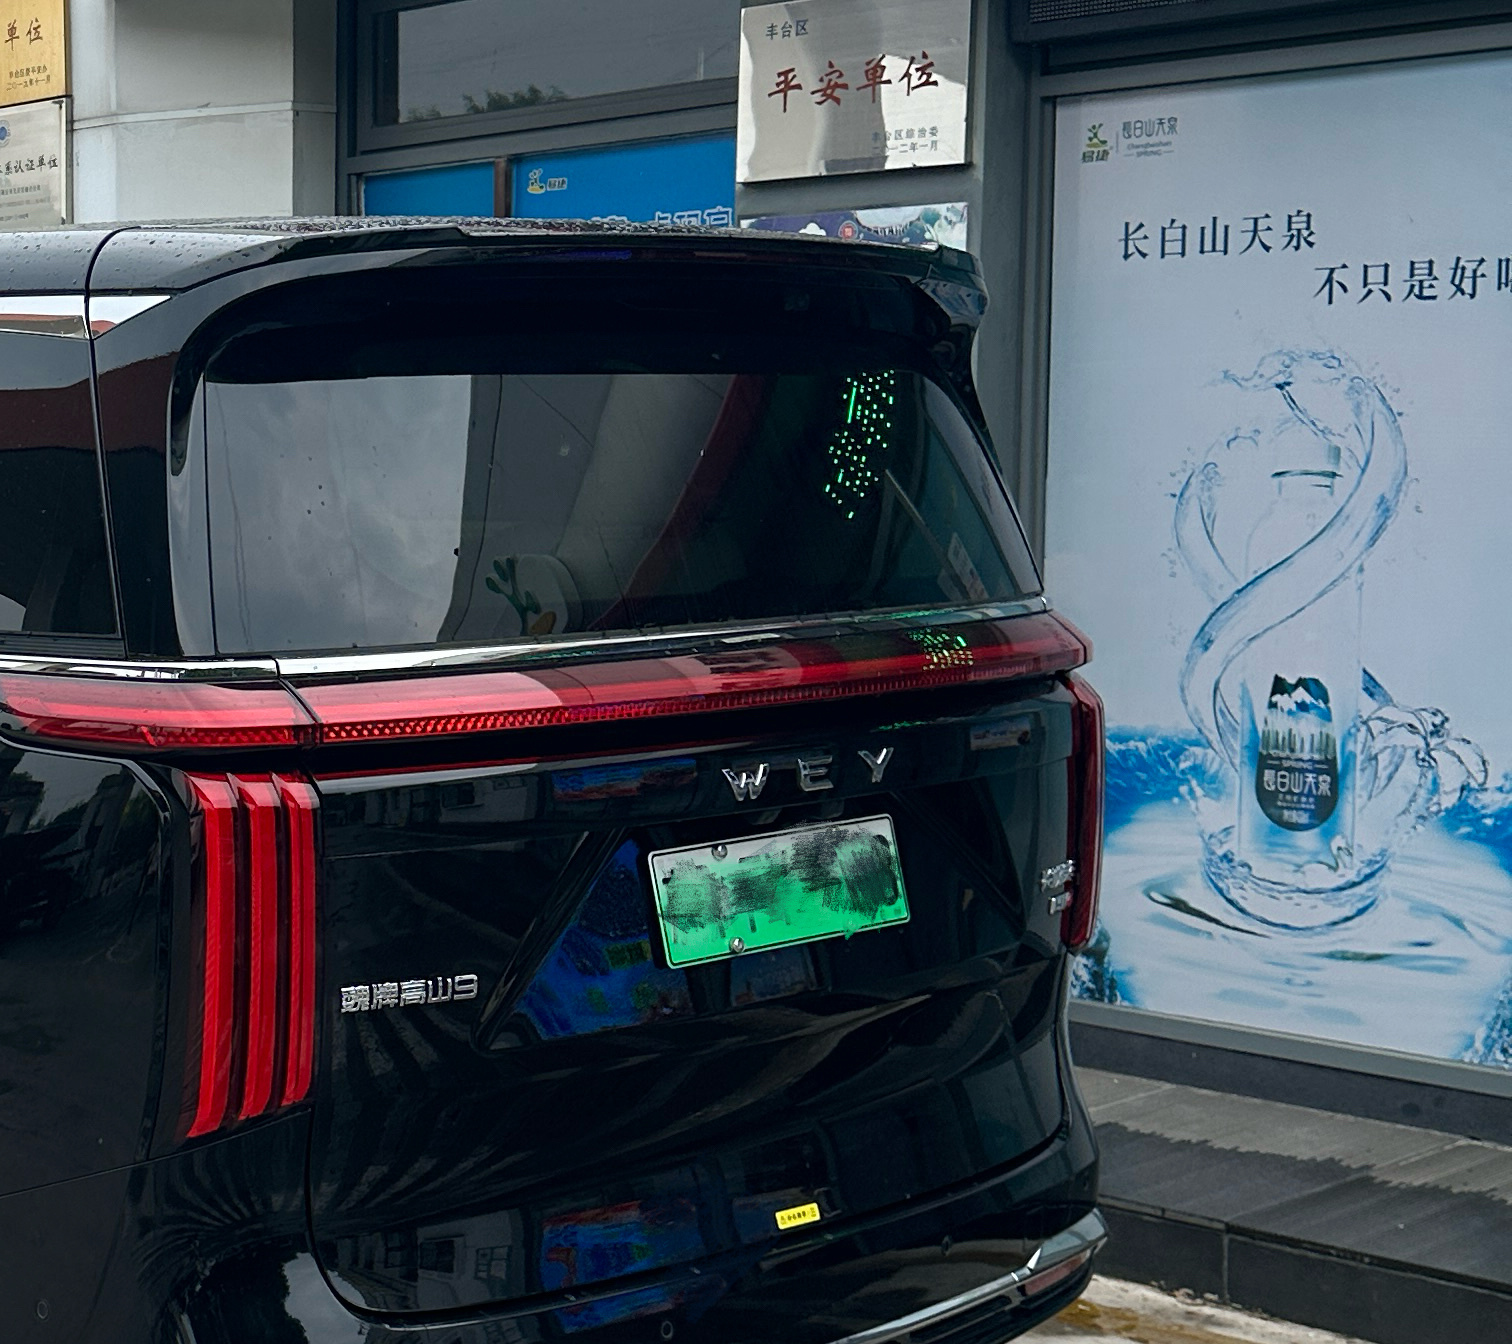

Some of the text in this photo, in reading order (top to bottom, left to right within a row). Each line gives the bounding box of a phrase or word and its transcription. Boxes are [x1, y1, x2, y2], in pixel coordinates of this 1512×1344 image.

[765, 18, 809, 40] 丰台区
[768, 50, 939, 113] 平安单位
[1118, 209, 1317, 262] 长白山天泉
[721, 747, 895, 802] WEY
[340, 974, 479, 1014] 魏牌高山9
